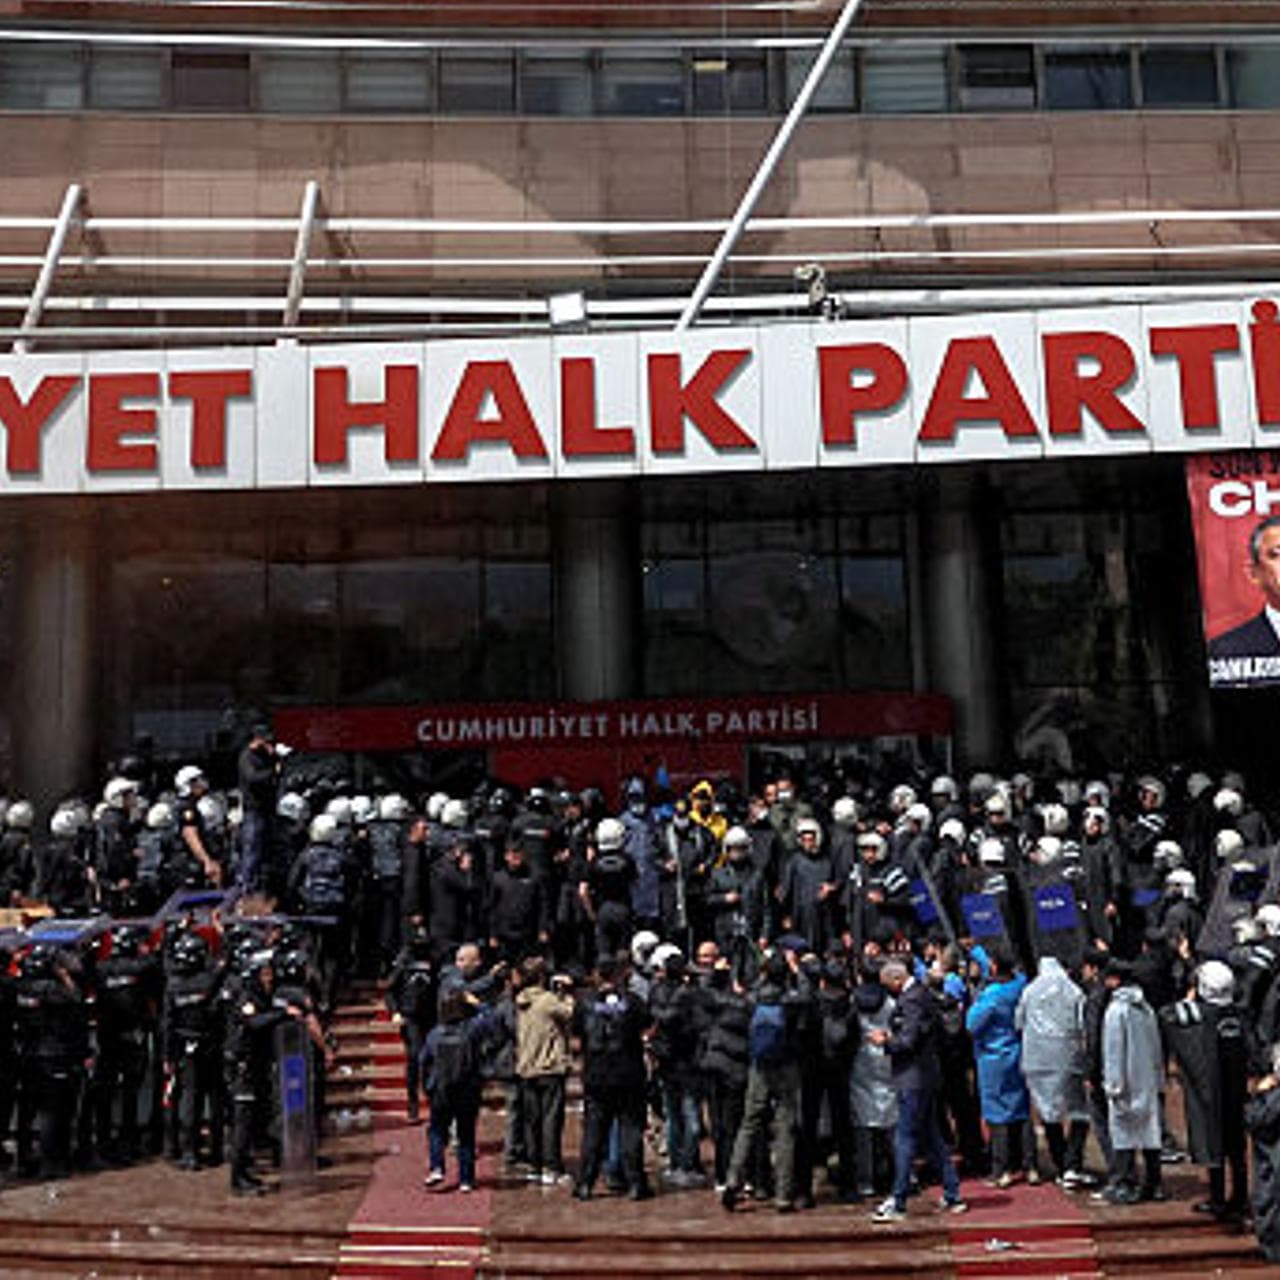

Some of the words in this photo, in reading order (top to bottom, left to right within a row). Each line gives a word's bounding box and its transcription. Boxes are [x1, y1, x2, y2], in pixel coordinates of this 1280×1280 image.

[314, 349, 757, 463] HALK
[416, 707, 609, 742] CUMHURİYET
[619, 712, 696, 737] HALK
[706, 702, 819, 734] PARTİSİ
